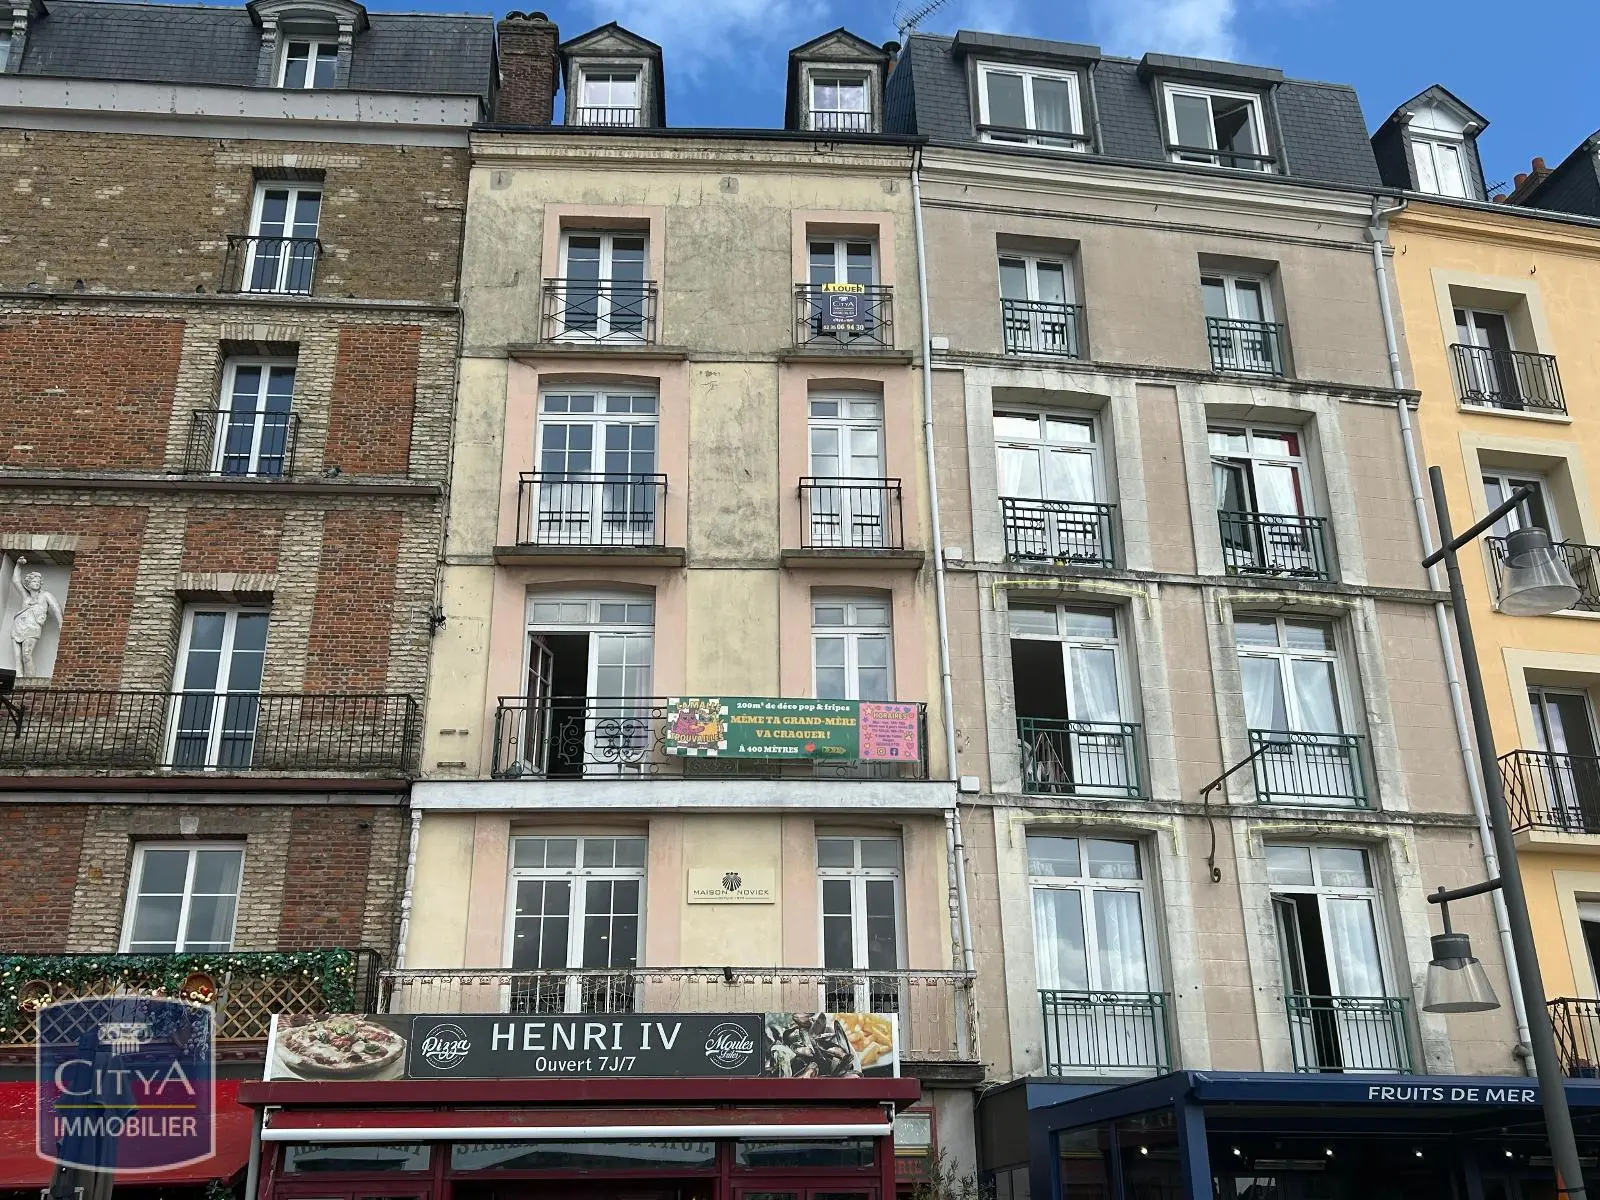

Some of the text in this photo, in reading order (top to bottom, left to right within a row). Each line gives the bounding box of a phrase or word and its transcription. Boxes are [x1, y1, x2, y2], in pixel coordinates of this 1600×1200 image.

[777, 702, 798, 710] déco
[799, 704, 815, 712] pop
[816, 703, 823, 711] &
[824, 703, 850, 712] fripes
[766, 716, 781, 725] TA
[873, 712, 908, 720] HORAIRES
[756, 729, 771, 738] VA
[773, 730, 826, 739] CRAQUER
[764, 744, 799, 753] MÈTRES
[491, 1022, 682, 1051] HENRI IV
[704, 1033, 754, 1051] Moules
[421, 1036, 471, 1060] Pizza
[535, 1056, 636, 1072] Ouvert 7J/7
[1368, 1086, 1535, 1103] FRUITS DE MER
